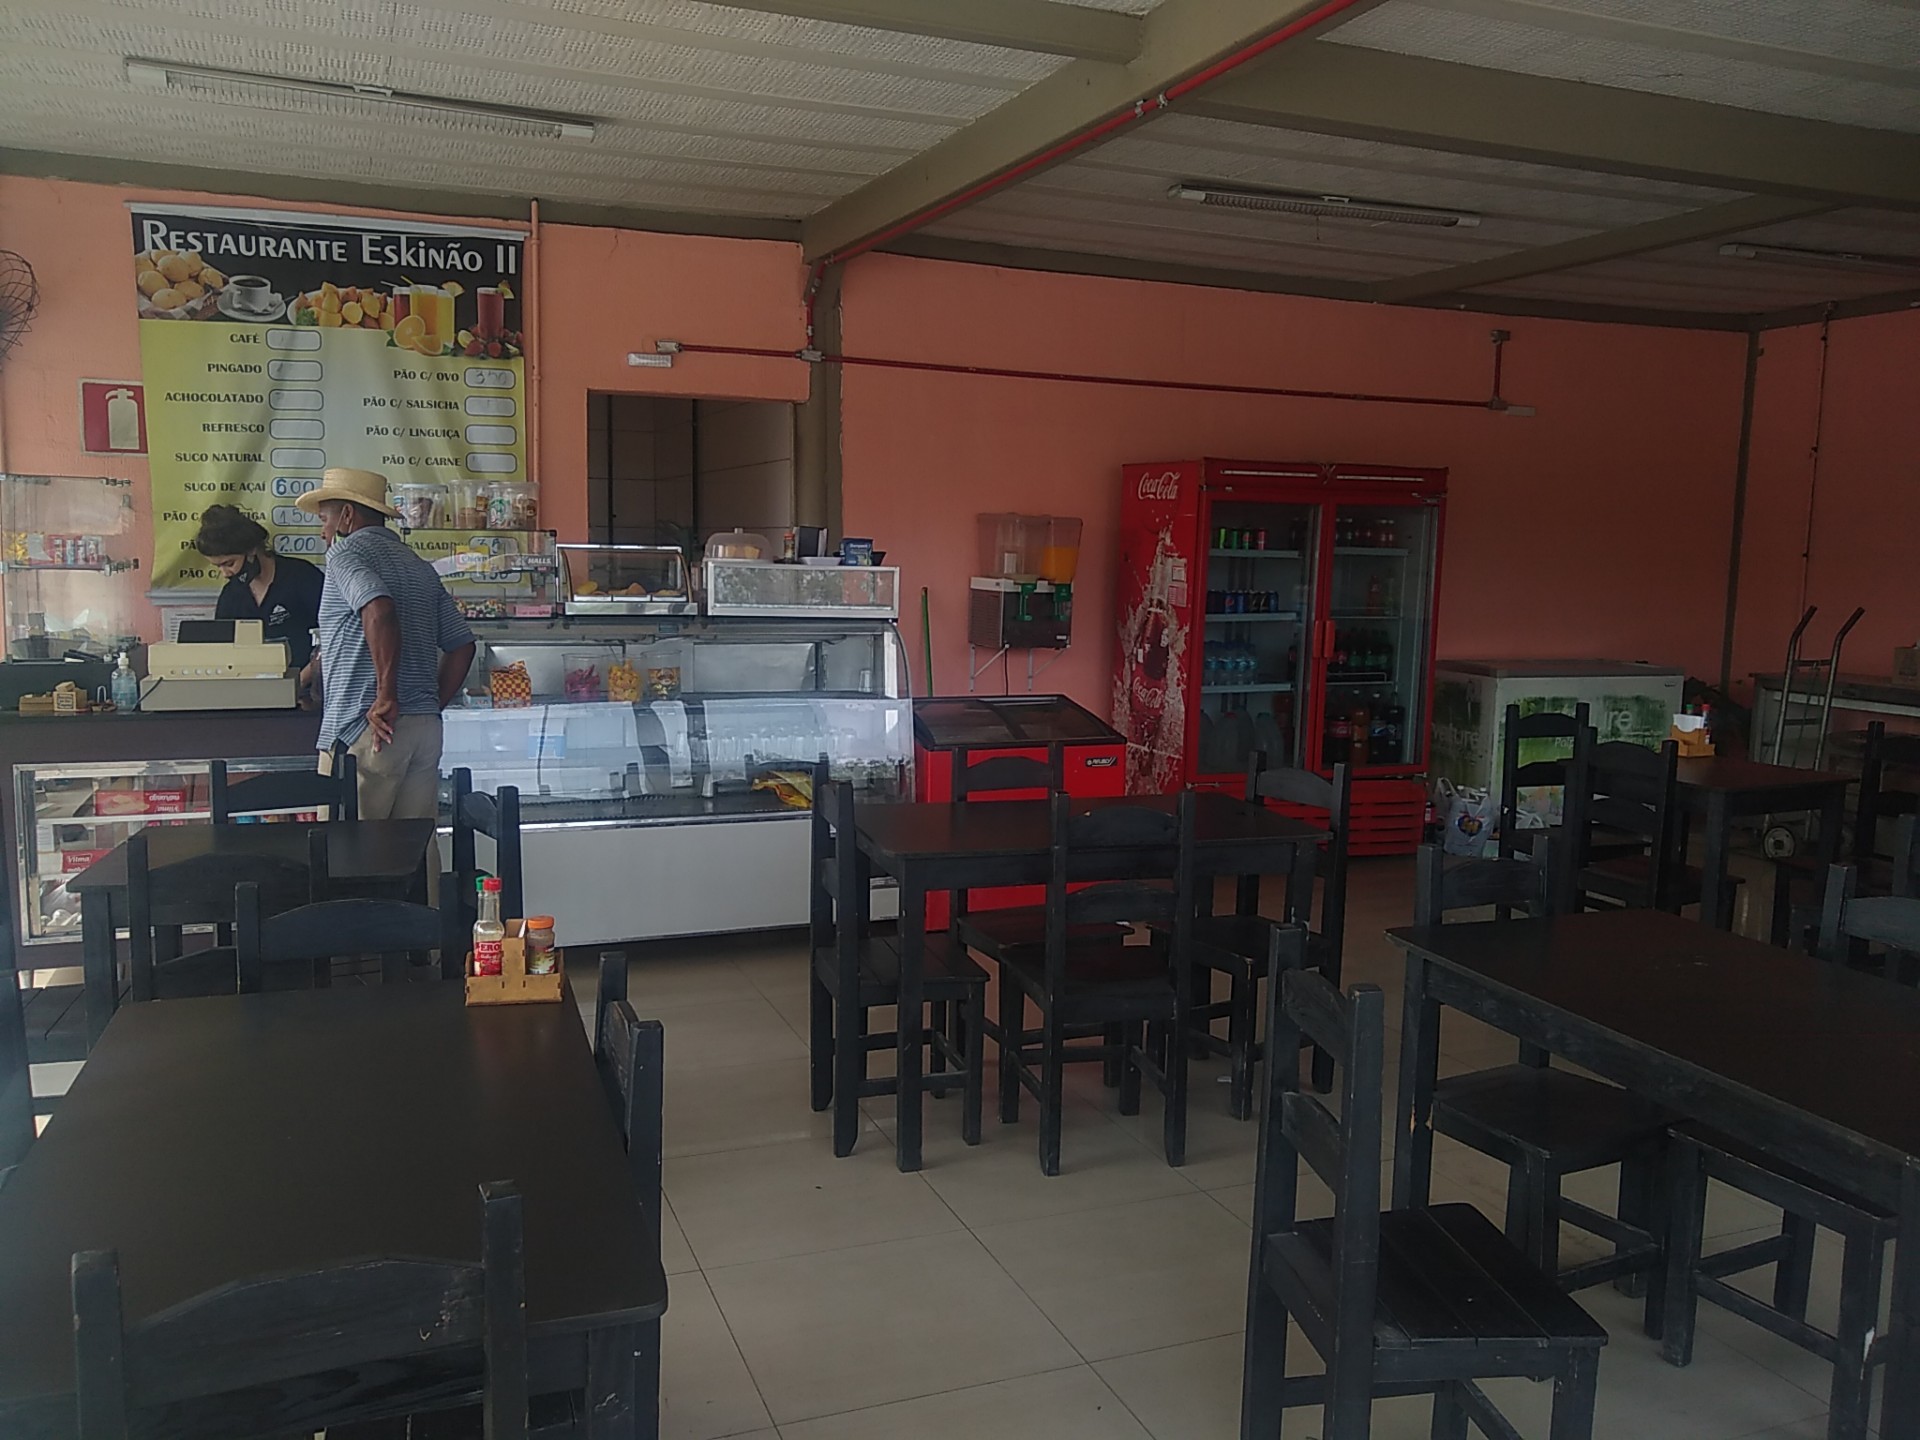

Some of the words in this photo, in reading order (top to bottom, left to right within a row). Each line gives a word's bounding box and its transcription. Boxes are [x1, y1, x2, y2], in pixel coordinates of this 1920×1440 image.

[142, 219, 348, 263] RESTAURANTE
[495, 245, 517, 274] II
[229, 333, 261, 345] CAFÉ
[207, 362, 262, 375] PINGADO
[393, 367, 416, 381] PÃO
[419, 369, 432, 382] C/
[436, 370, 459, 383] OVO
[165, 391, 264, 405] ACHOCOLATADO
[363, 396, 385, 409] PÃO
[389, 397, 403, 410] C/
[406, 398, 460, 411] SALSICHA
[201, 422, 265, 434] REFRESCO
[366, 424, 388, 437] PÃO
[392, 425, 406, 438] C/
[408, 426, 460, 441] LINGUIÇA
[175, 452, 211, 463] SUCO
[214, 451, 265, 463] NATURAL
[382, 452, 405, 466] PÃO
[408, 454, 422, 467] C/
[425, 455, 462, 467] CARNE
[184, 481, 217, 493] SUCO
[220, 481, 238, 492] DE
[240, 479, 267, 495] AÇAÍ
[163, 511, 188, 523] PÃO
[180, 538, 198, 550] PÃ
[527, 557, 552, 565] HALLS
[179, 567, 204, 578] PÃO
[208, 568, 222, 579] C/
